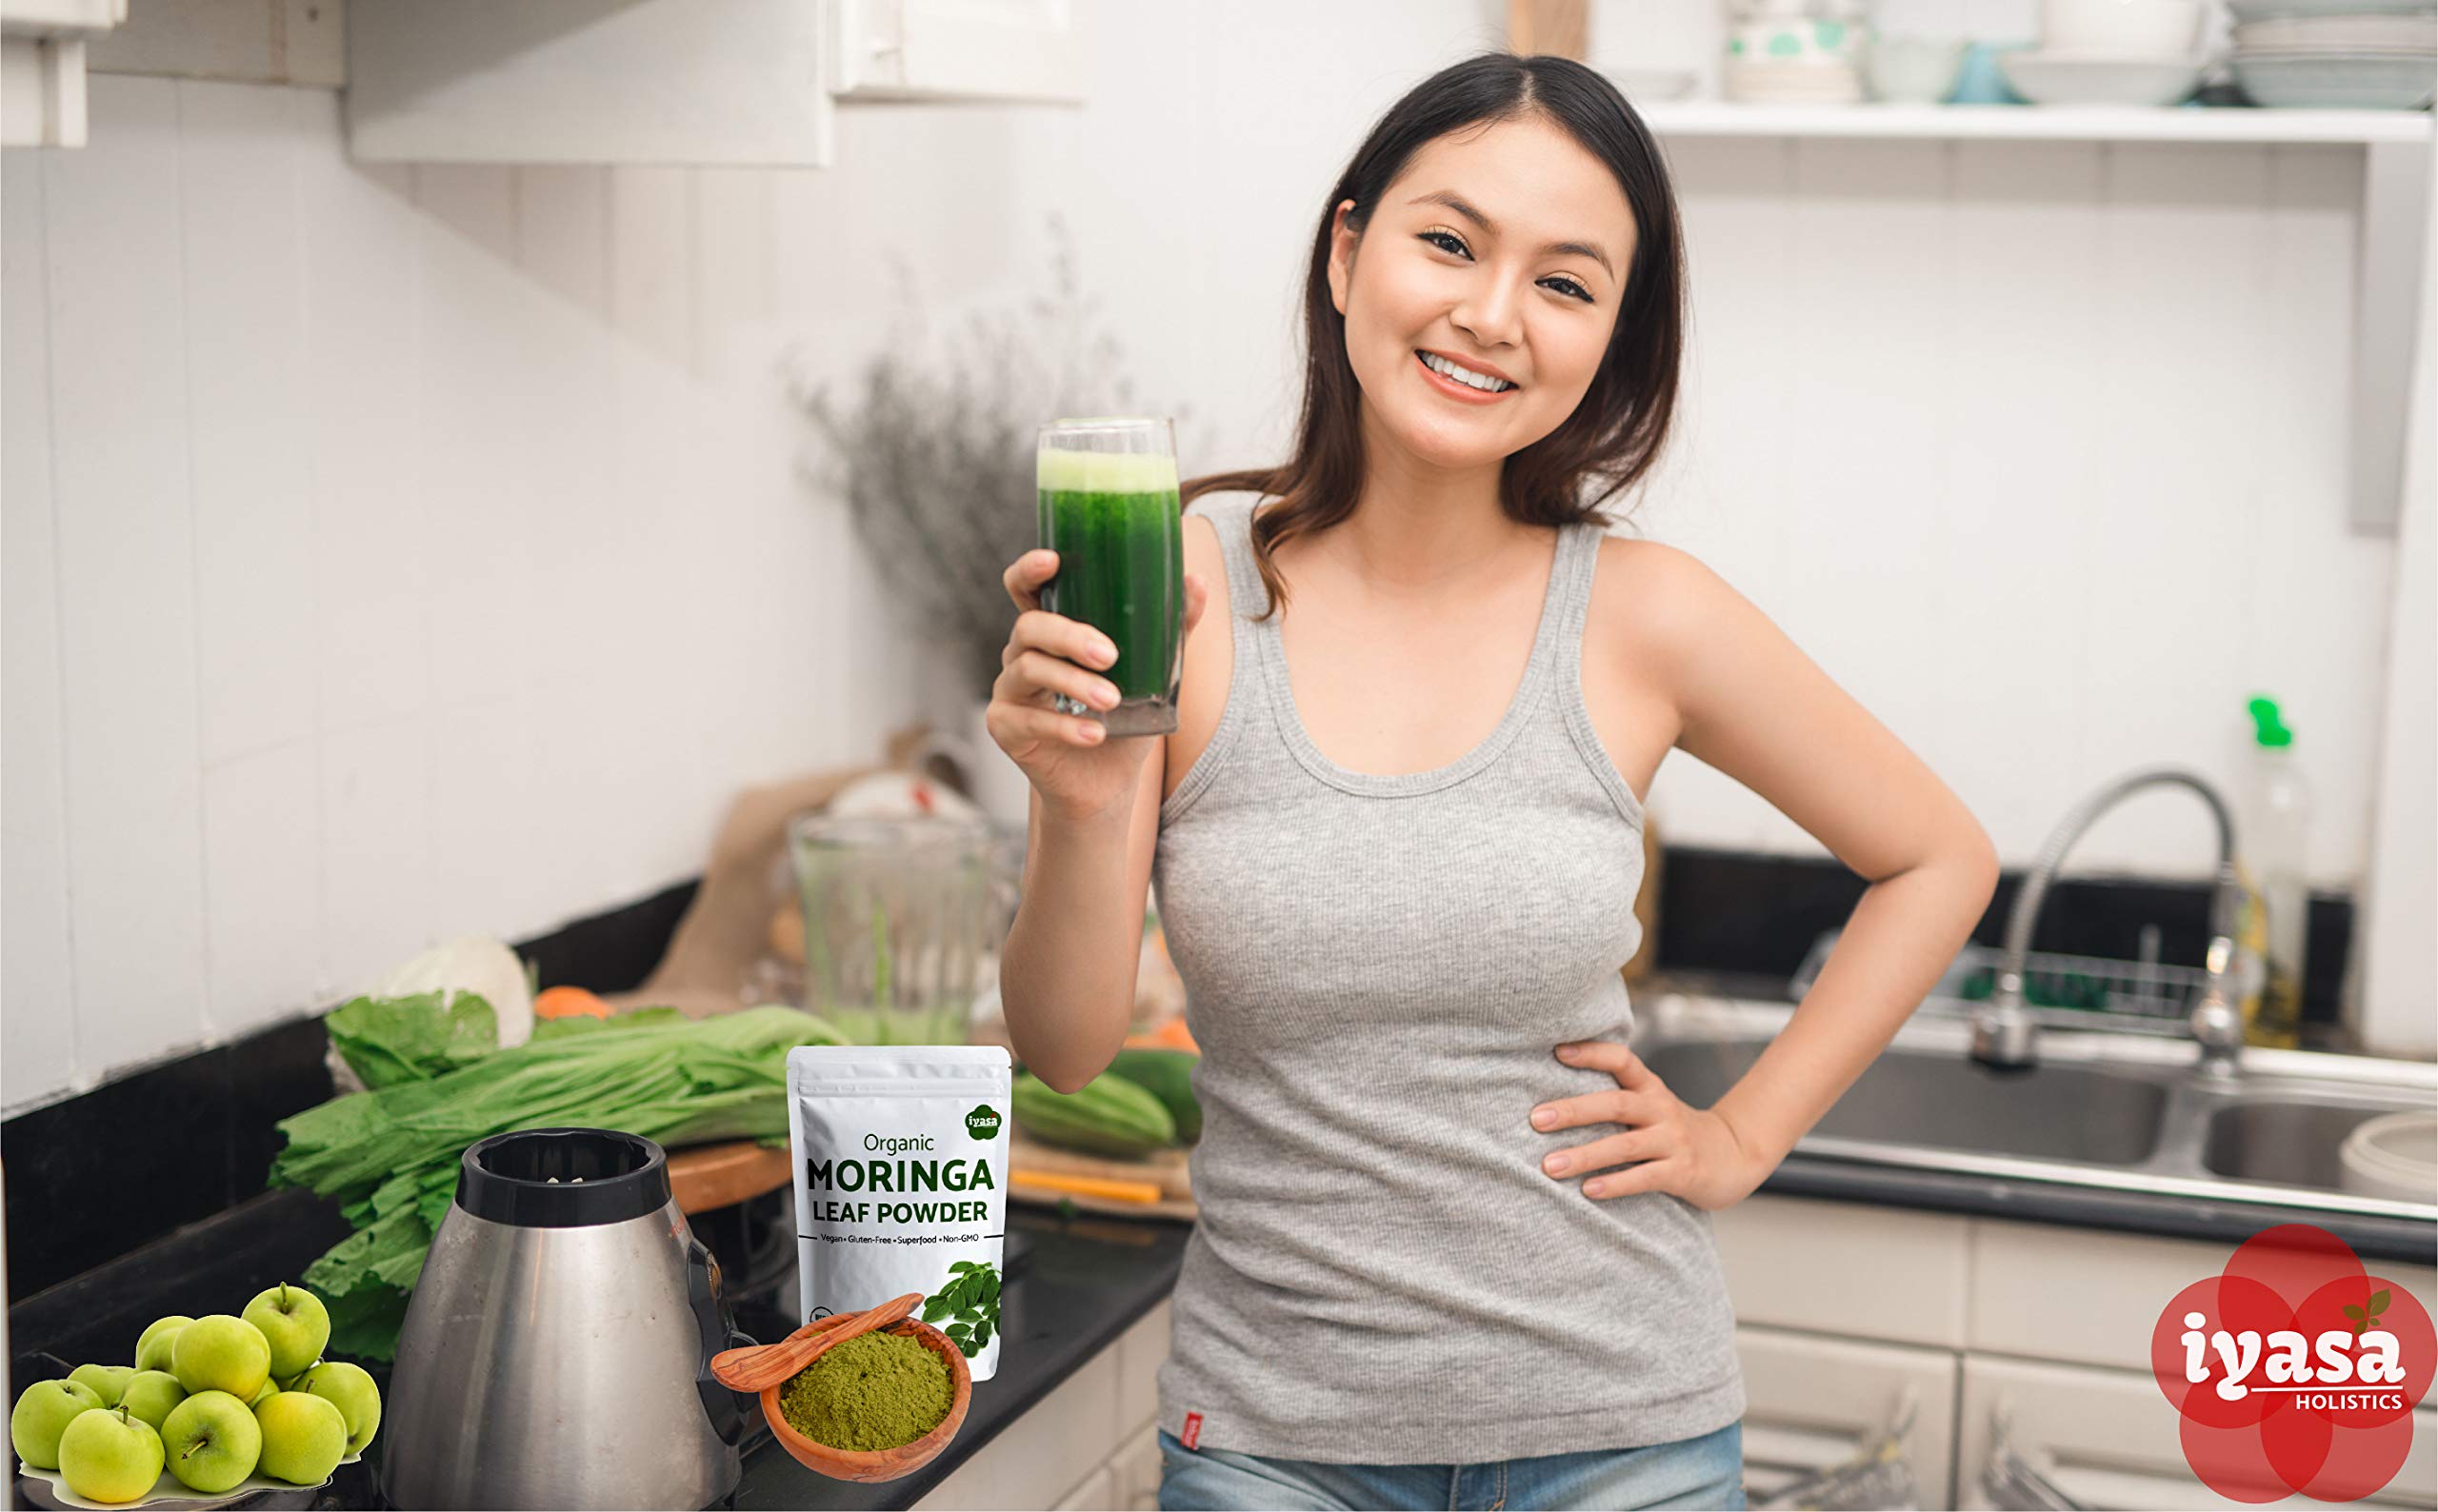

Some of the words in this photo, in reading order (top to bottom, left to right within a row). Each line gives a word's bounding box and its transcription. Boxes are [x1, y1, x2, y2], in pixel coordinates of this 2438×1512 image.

[969, 1115, 998, 1127] iyasa
[864, 1133, 934, 1156] Organic
[808, 1158, 995, 1192] MORINGA
[813, 1201, 870, 1223] LEAF
[877, 1201, 989, 1224] POWDER
[820, 1233, 843, 1244] Vegan
[848, 1235, 892, 1244] Gluten-Free
[897, 1235, 937, 1245] Superfood
[943, 1233, 980, 1243] Non-GMO
